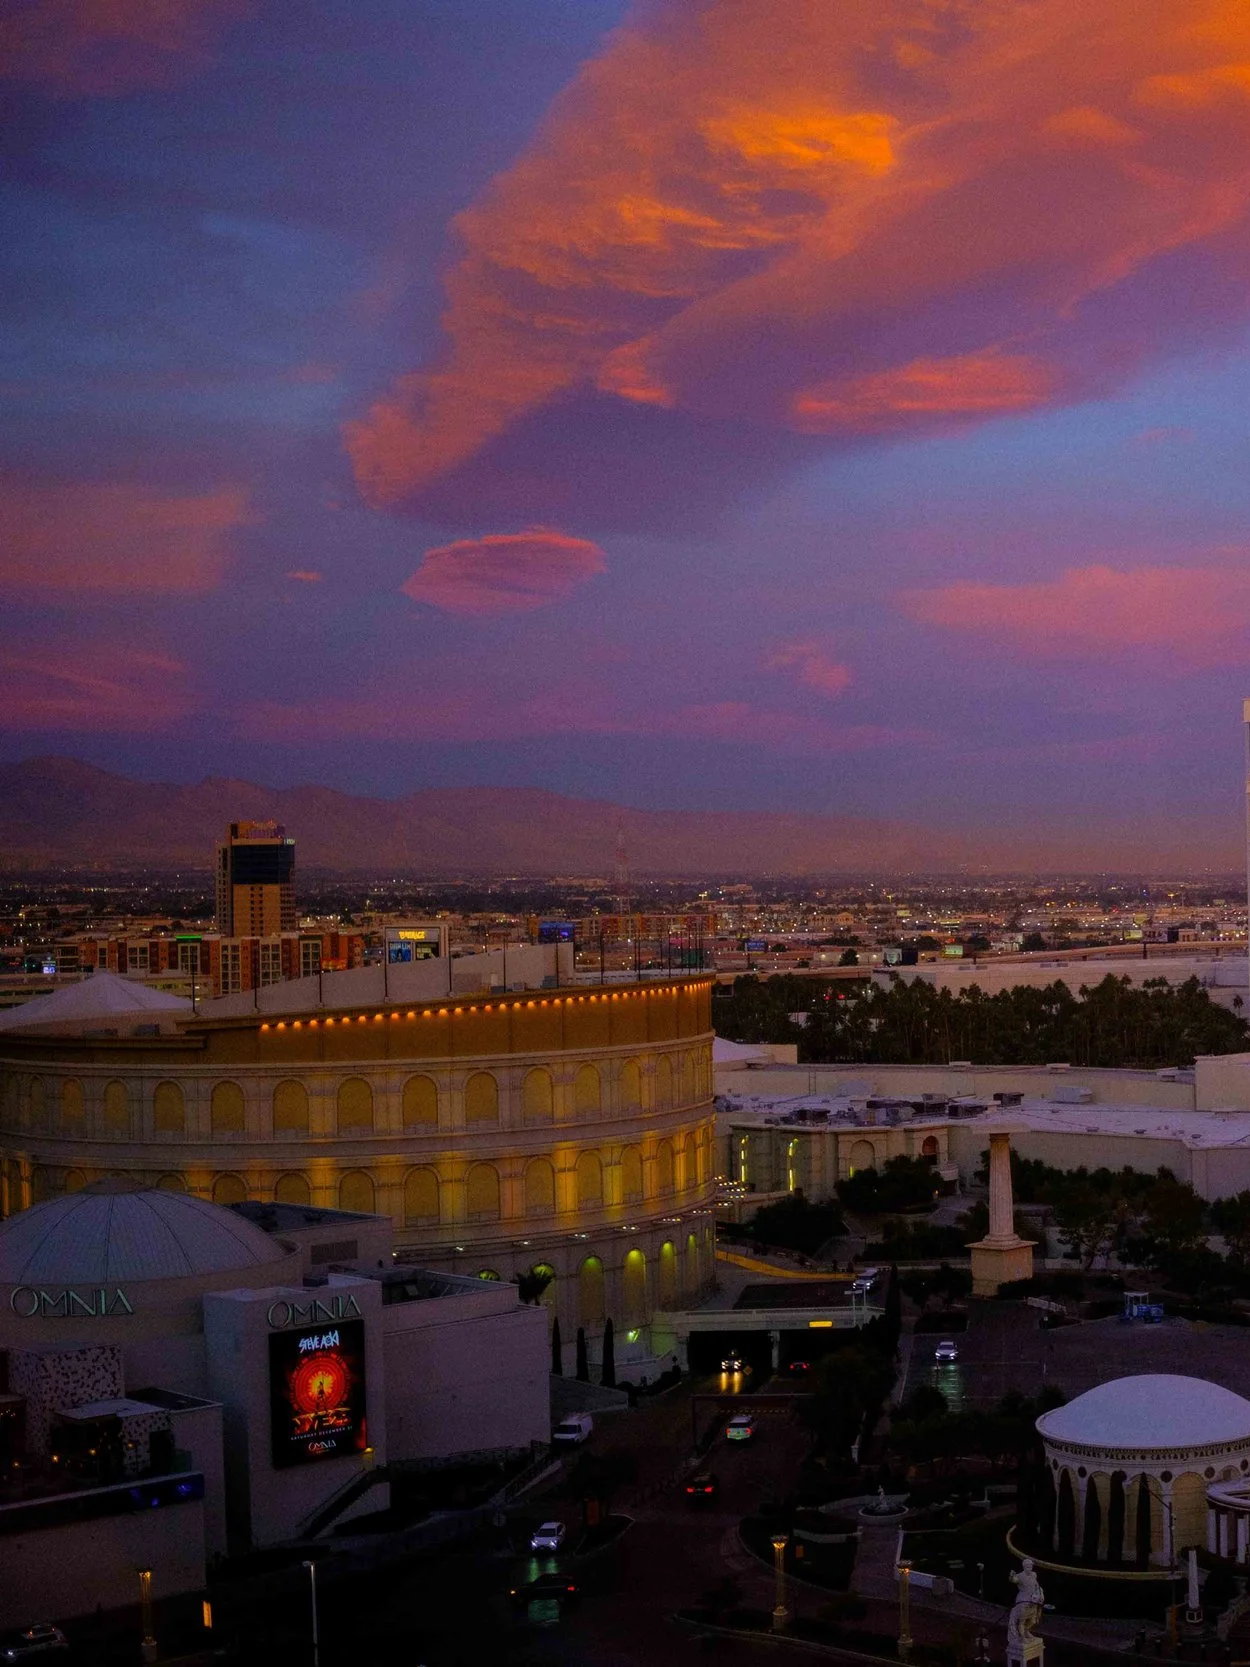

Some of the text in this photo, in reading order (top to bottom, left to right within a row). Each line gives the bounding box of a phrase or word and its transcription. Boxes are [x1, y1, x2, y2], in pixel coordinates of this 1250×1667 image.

[10, 1286, 134, 1317] OMNIA
[268, 1294, 362, 1329] OMNIA
[299, 1334, 320, 1353] STEVE
